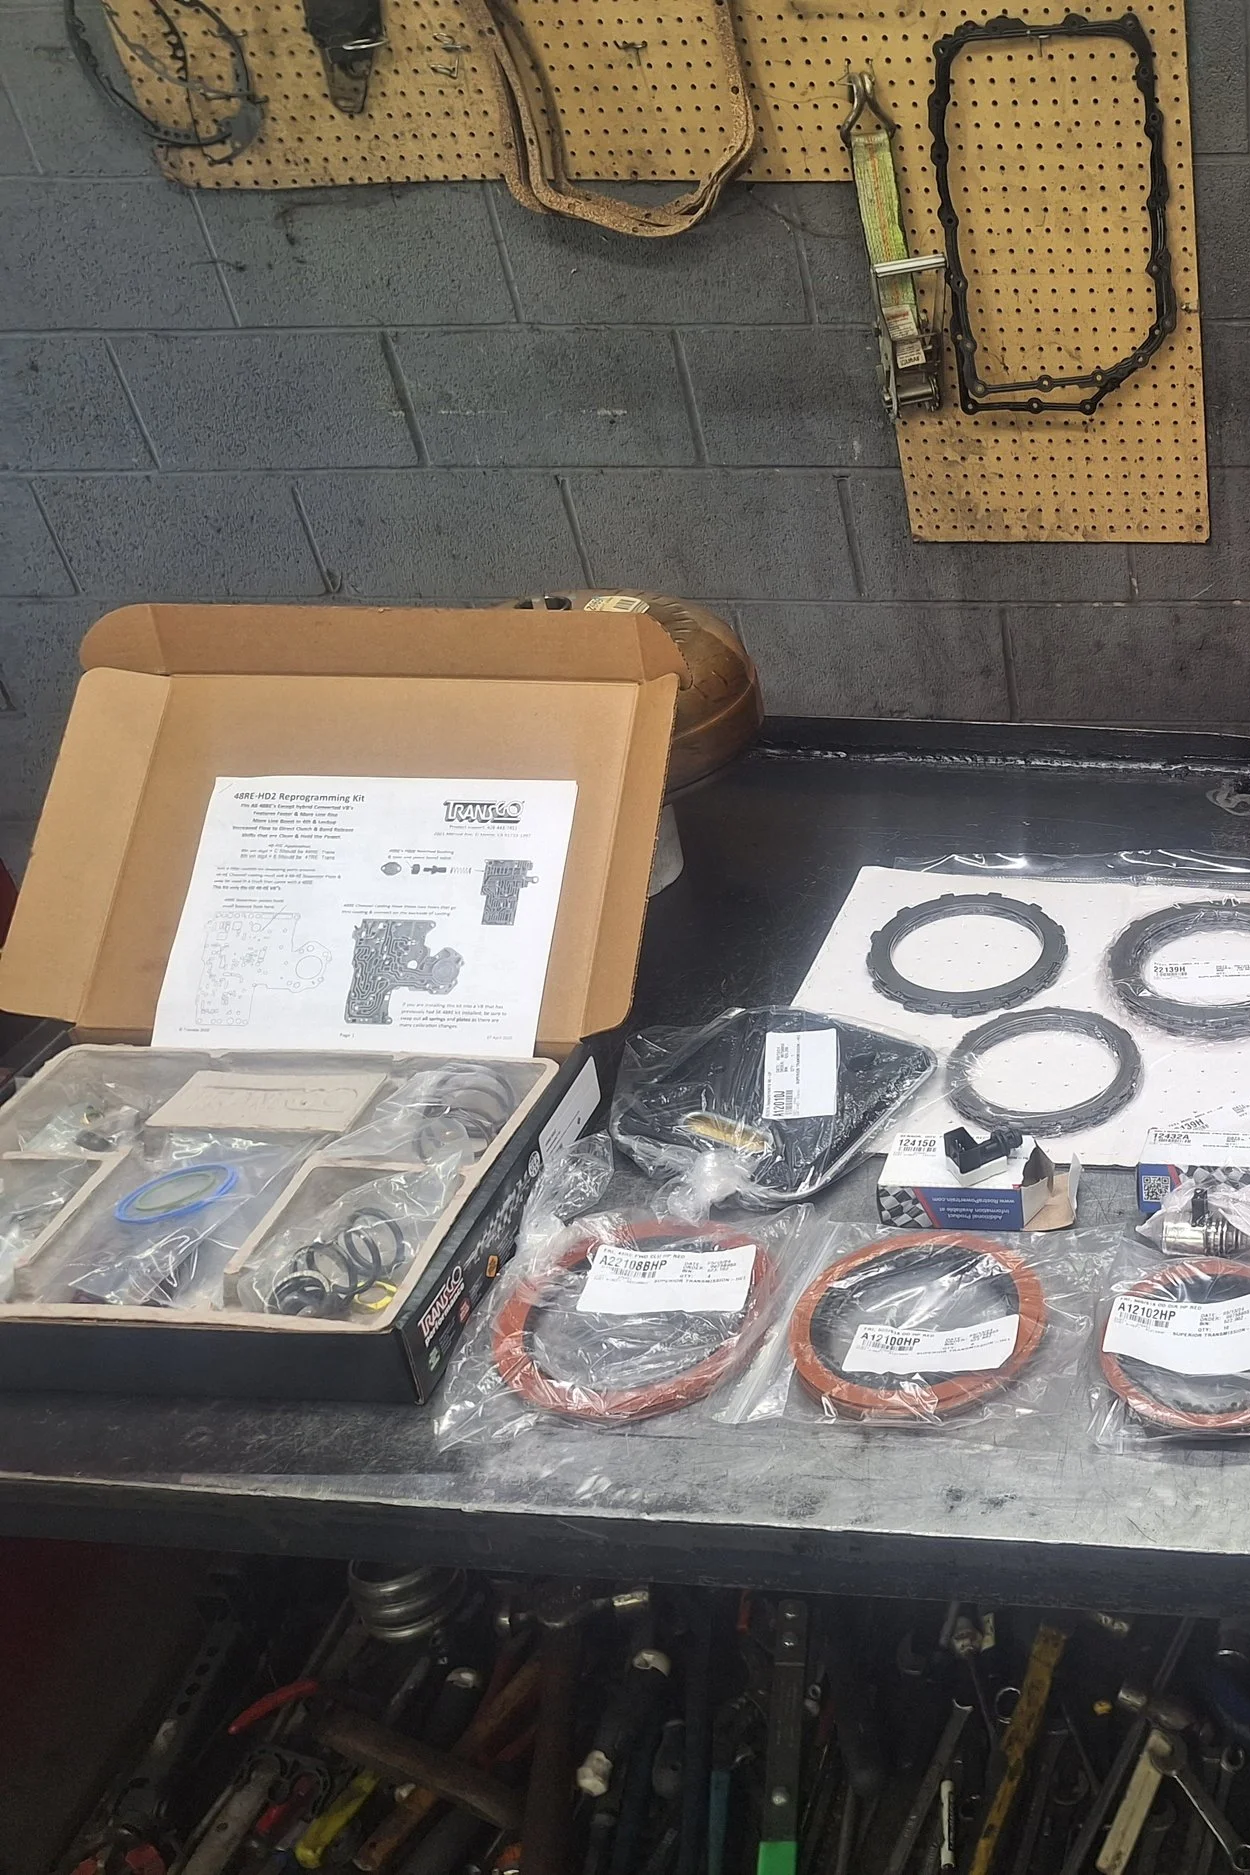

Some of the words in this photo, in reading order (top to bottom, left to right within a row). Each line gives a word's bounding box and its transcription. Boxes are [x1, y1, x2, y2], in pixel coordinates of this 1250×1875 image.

[234, 792, 277, 800] 48RE-HD2
[279, 793, 351, 803] Reprogramming
[443, 799, 524, 824] TRANSGO
[899, 1139, 936, 1147] 12415D
[1153, 1133, 1190, 1141] 12432A
[599, 1255, 668, 1272] A22108BHP
[416, 1265, 464, 1336] TRANSGO
[424, 1281, 465, 1348] performance
[1117, 1302, 1176, 1321] A12102HP
[860, 1332, 920, 1346] A12100HP
